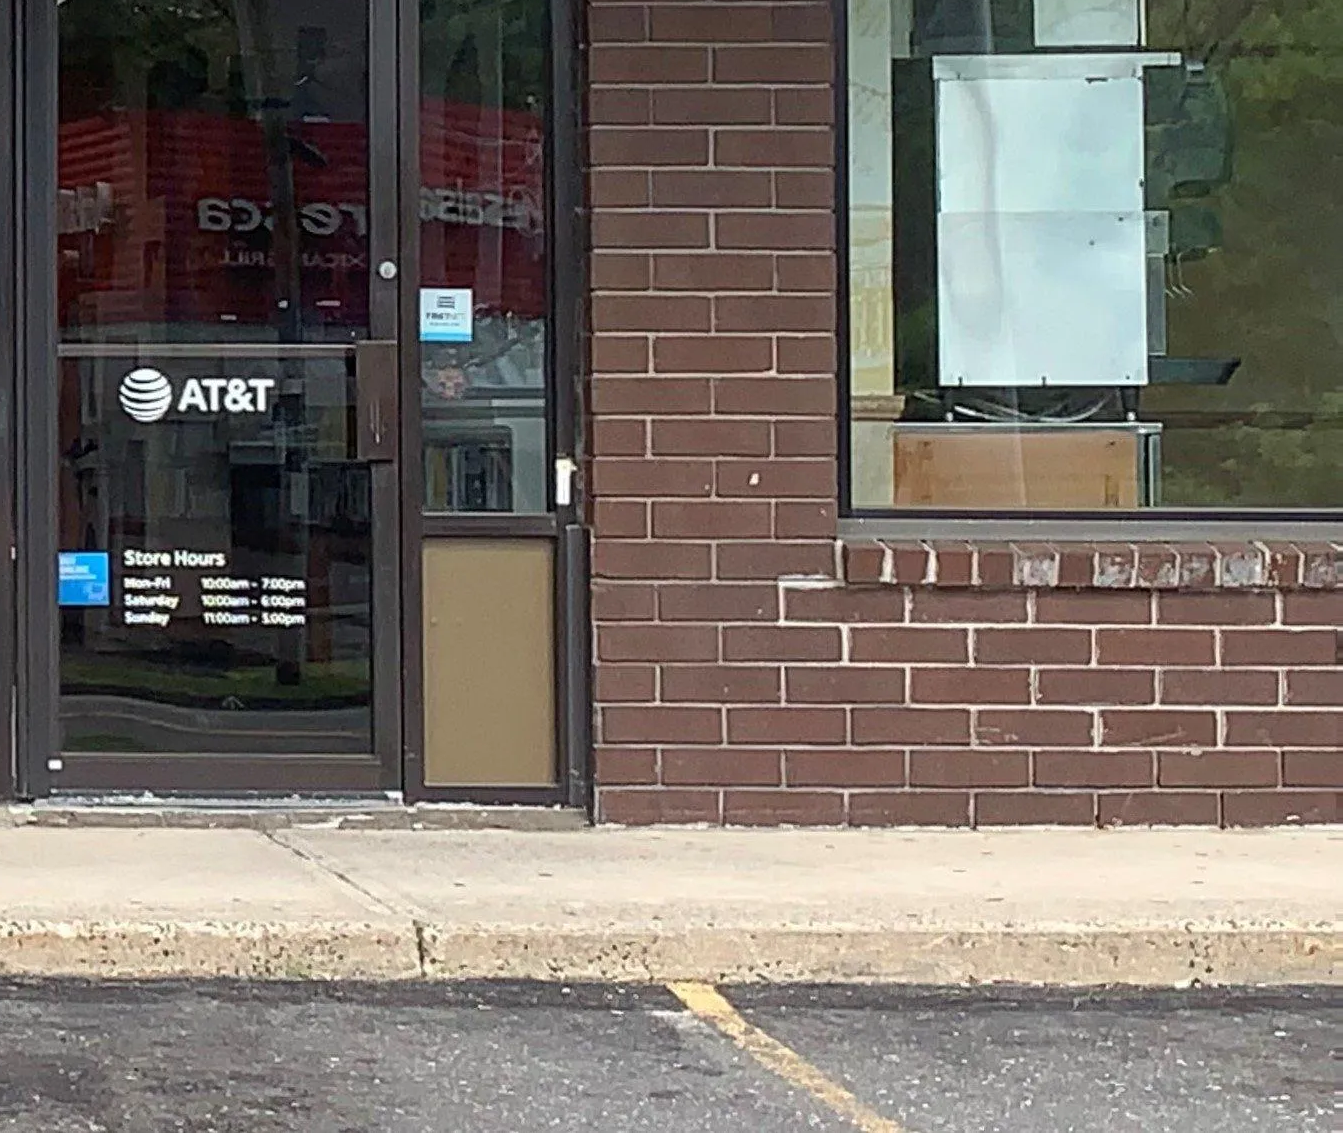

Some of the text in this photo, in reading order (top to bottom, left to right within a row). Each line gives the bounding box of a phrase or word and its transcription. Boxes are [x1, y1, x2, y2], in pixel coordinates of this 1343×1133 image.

[177, 378, 275, 412] AT&T
[124, 549, 226, 567] Store Hours
[123, 576, 172, 590] Mon-Fri
[123, 593, 180, 609] Saturday
[124, 610, 170, 627] Sunday
